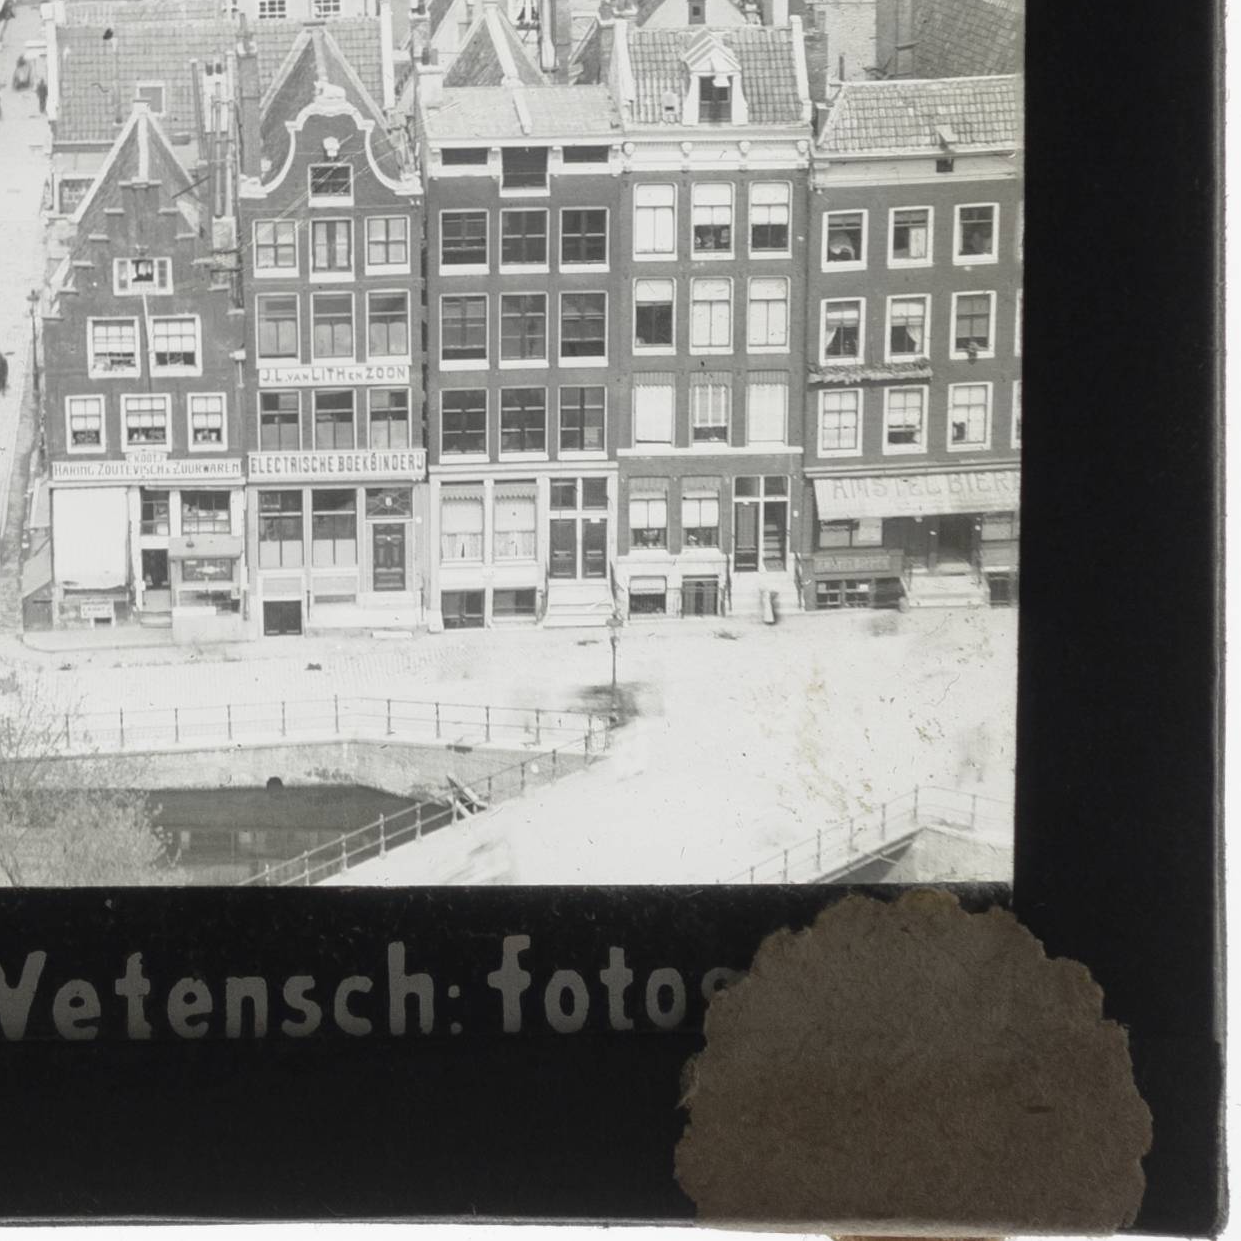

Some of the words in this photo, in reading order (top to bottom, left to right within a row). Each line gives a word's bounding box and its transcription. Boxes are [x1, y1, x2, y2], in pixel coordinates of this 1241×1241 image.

[311, 367, 346, 381] LITH
[365, 366, 407, 380] ZOON
[53, 462, 95, 477] HARING
[249, 455, 334, 475] ELECTRISCHE
[832, 475, 943, 500] AMSTEL
[947, 471, 1010, 495] BIER
